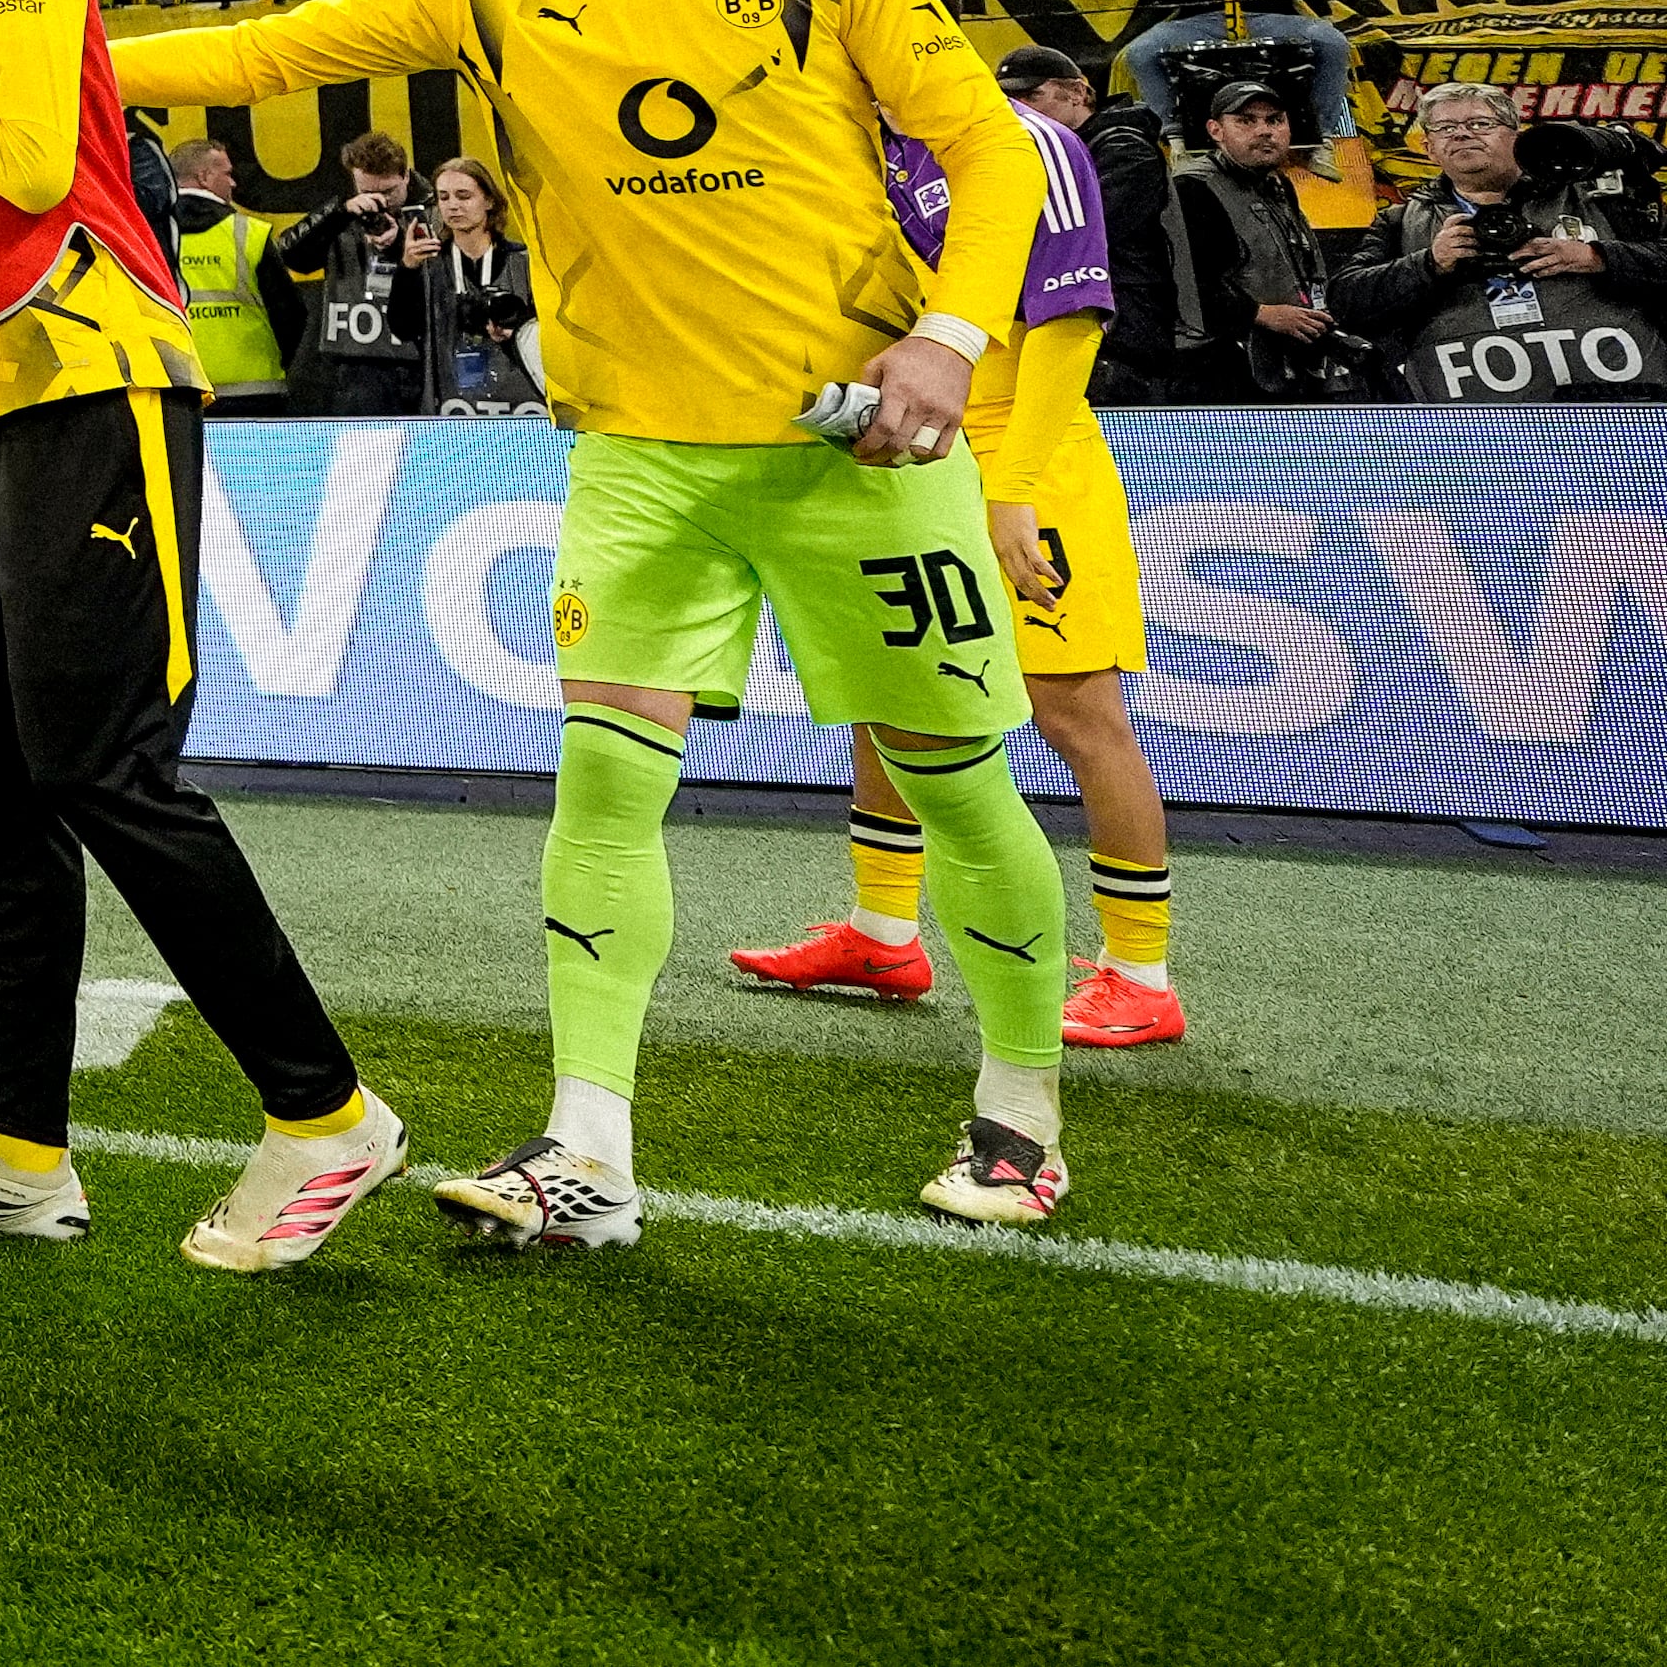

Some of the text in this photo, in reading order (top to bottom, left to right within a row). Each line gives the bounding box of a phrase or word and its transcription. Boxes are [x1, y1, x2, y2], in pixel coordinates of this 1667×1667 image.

[741, 12, 760, 25] 09
[911, 34, 965, 62] Poles
[1602, 51, 1667, 85] DE
[606, 166, 765, 196] vodafone
[182, 255, 221, 267] OWER
[188, 306, 240, 320] SECURITY
[1436, 327, 1643, 399] FOTO
[858, 548, 995, 648] 30
